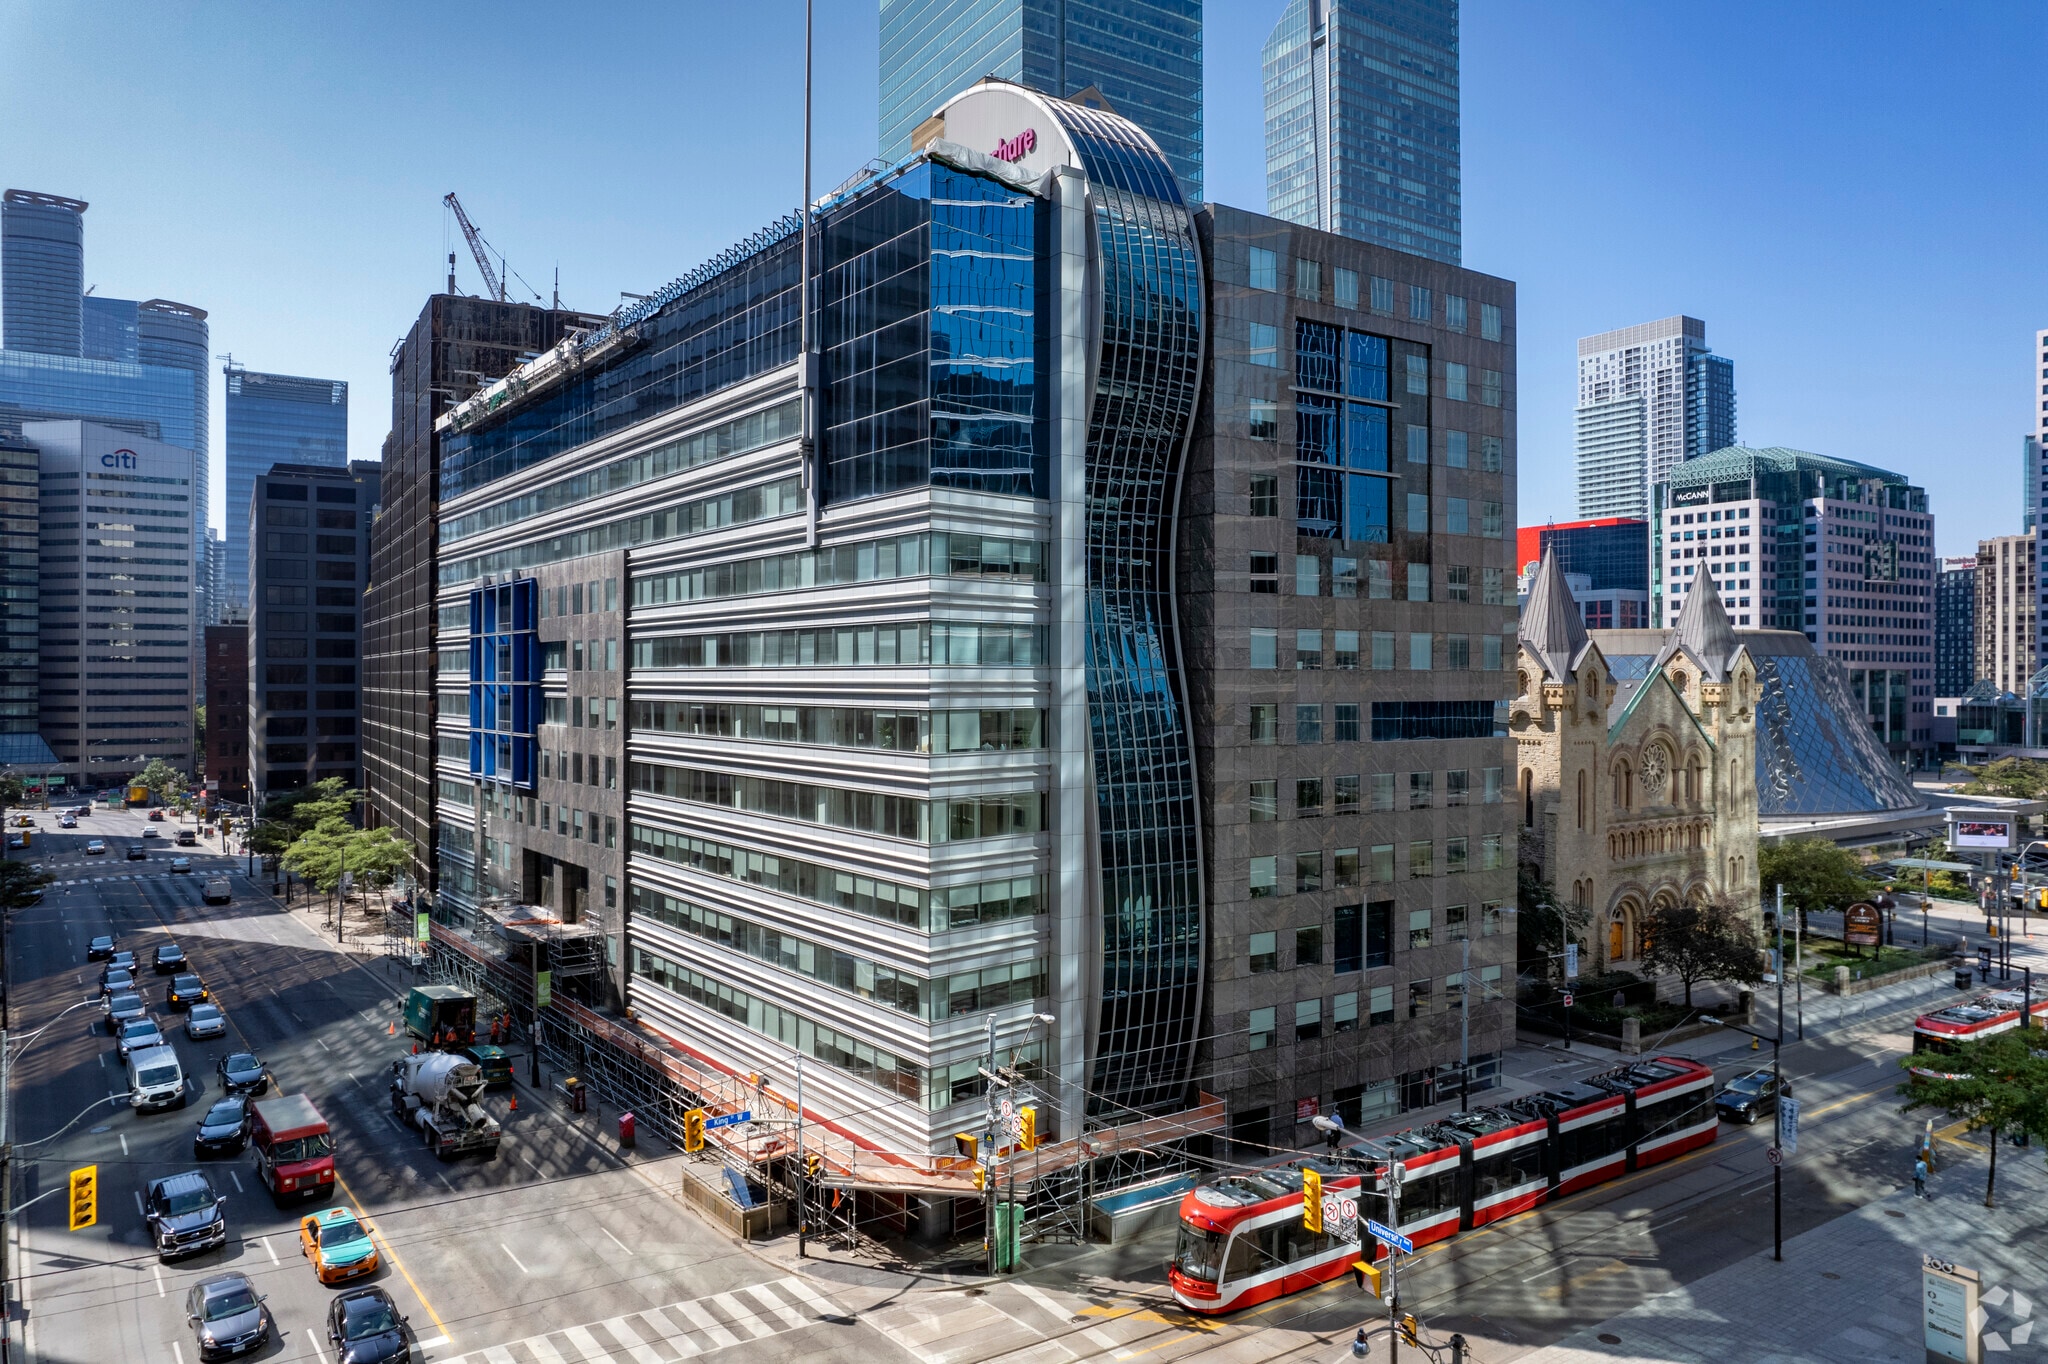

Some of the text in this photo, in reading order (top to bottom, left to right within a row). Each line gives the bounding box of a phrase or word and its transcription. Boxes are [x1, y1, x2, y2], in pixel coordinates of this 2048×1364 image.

[101, 452, 136, 469] citi
[714, 1117, 728, 1126] King
[1371, 1222, 1403, 1247] University
